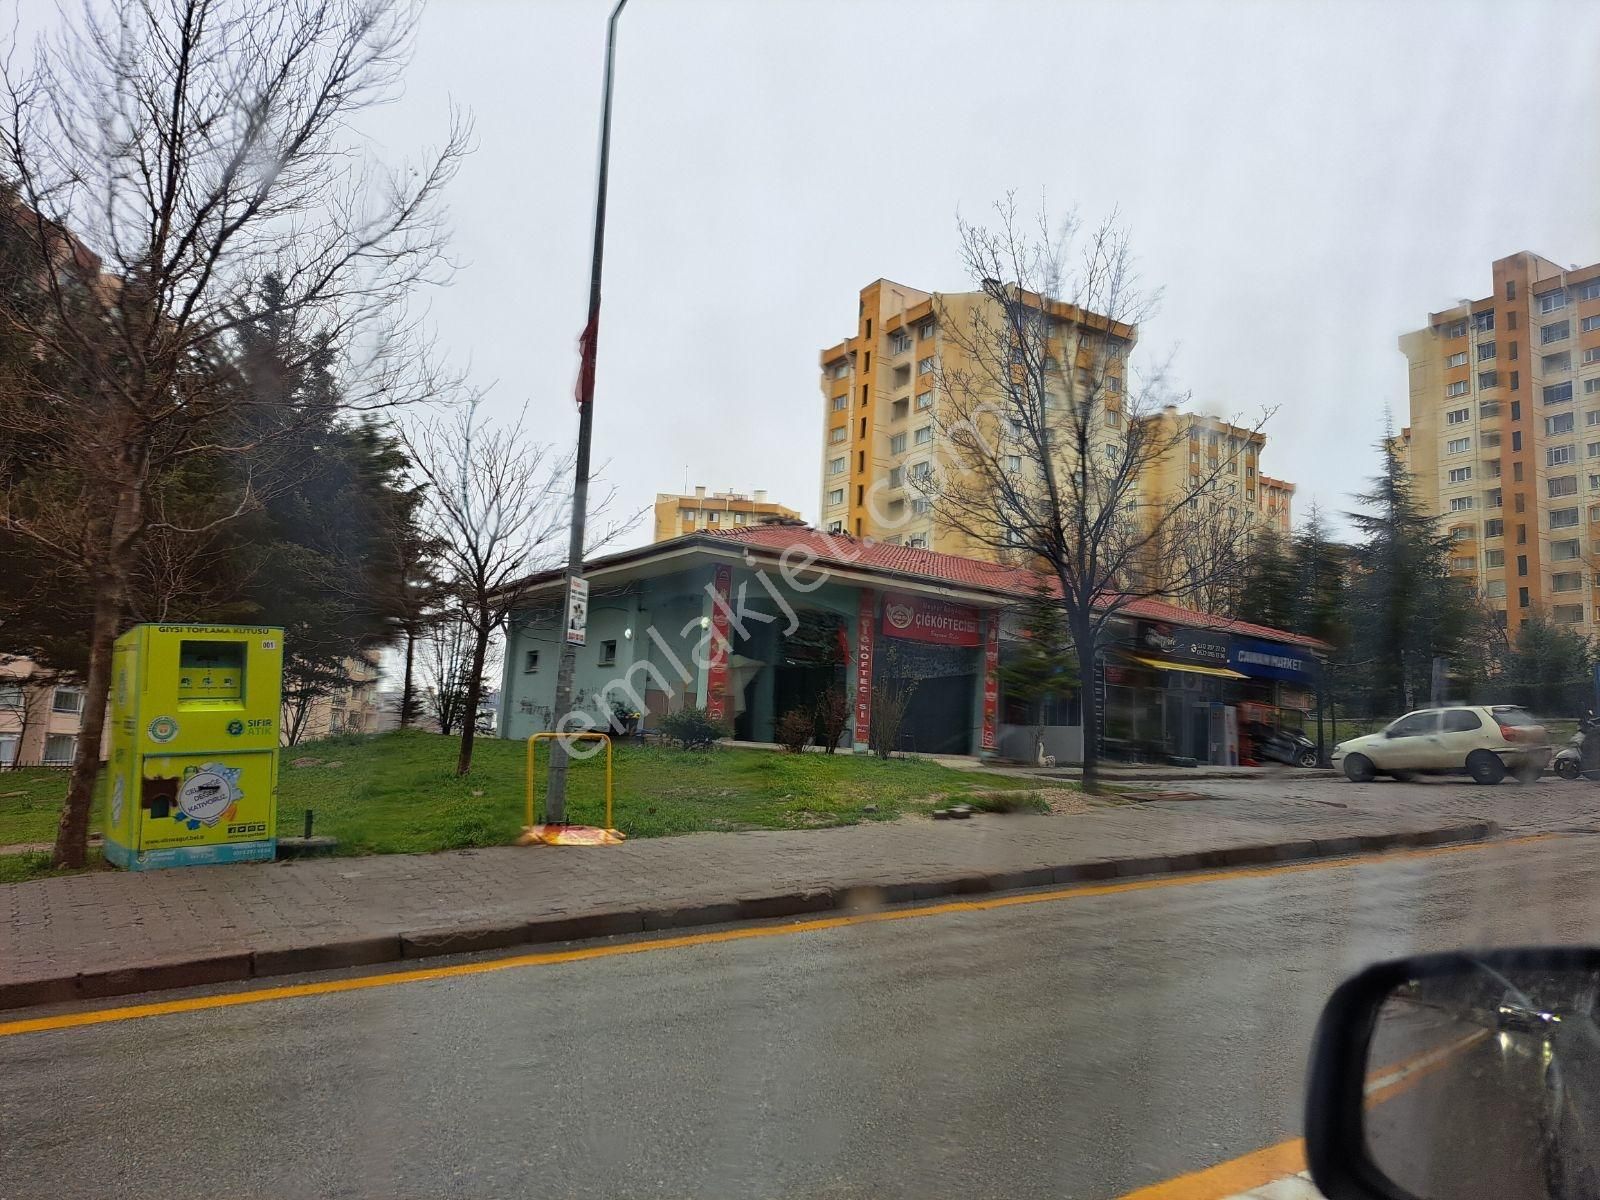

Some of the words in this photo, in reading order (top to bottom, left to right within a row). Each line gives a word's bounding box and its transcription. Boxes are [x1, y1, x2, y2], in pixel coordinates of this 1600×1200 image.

[263, 641, 274, 649] 001
[247, 719, 272, 727] SIFIR
[247, 727, 272, 736] ATIK
